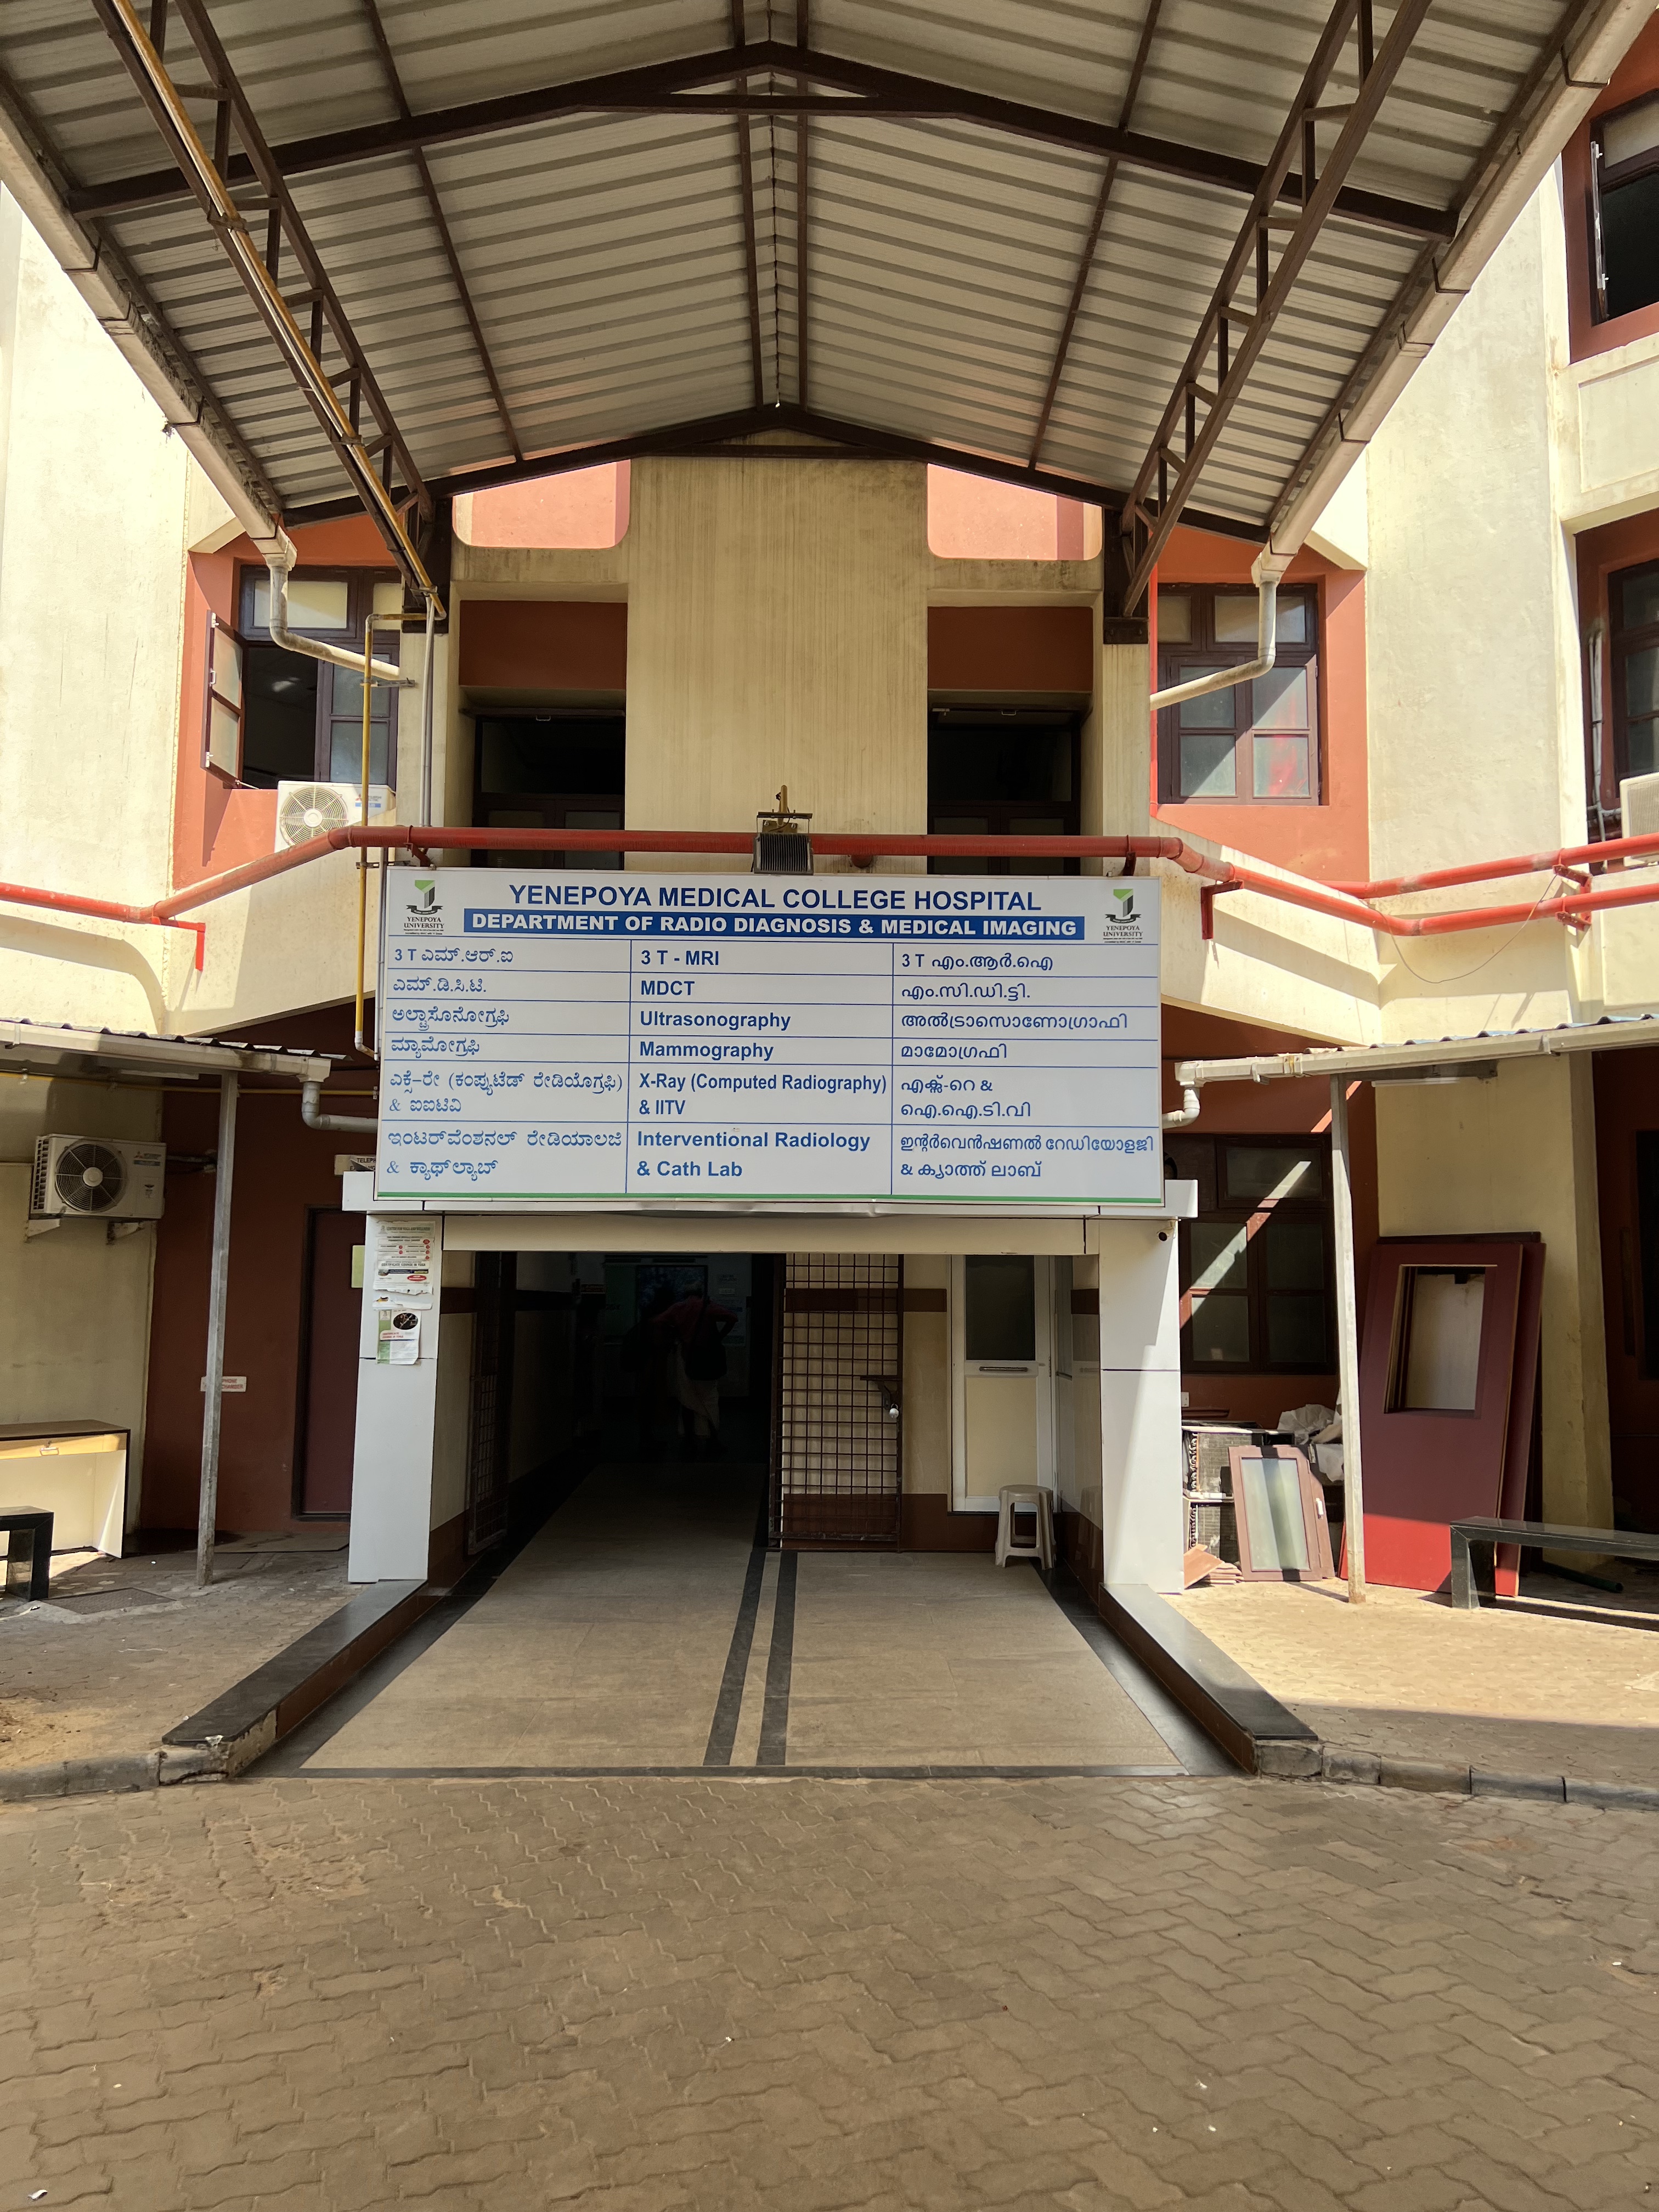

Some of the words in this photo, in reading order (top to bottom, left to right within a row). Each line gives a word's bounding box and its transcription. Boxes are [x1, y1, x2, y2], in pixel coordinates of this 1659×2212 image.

[509, 884, 652, 906] YENEPOYA
[659, 887, 775, 908] MEDICAL
[783, 889, 906, 910] COLLEGE
[915, 890, 1042, 911] HOSPITAL
[472, 913, 618, 930] DEPARTMENT
[625, 916, 653, 930] OF
[661, 917, 726, 932] RADIO
[734, 918, 851, 933] DIAGNOSIS
[859, 919, 873, 934] &
[882, 919, 976, 934] MEDICAL
[983, 921, 1076, 935] IMAGING
[394, 949, 403, 961] 3
[407, 949, 417, 961] T
[641, 950, 651, 965] 3
[657, 950, 668, 965] T
[685, 950, 719, 966] MRI
[901, 953, 910, 967] 3
[915, 953, 925, 967] T
[641, 980, 695, 996] MDCT
[640, 1011, 791, 1031] Ultrasonography
[640, 1041, 774, 1062] Mammography
[639, 1073, 686, 1092] X-Ray
[691, 1073, 777, 1093] (Computed
[782, 1074, 887, 1094] Radiography)
[980, 1080, 993, 1091] &
[389, 1098, 400, 1111] &
[639, 1099, 651, 1115] &
[656, 1099, 686, 1115] IITV
[637, 1131, 768, 1147] Interventional
[775, 1132, 870, 1152] Radiology
[386, 1161, 399, 1173] &
[636, 1160, 651, 1176] &
[657, 1160, 701, 1176] Cath
[708, 1161, 742, 1177] Lab
[900, 1164, 913, 1175] &
[991, 1160, 1042, 1177] ലാബ്
